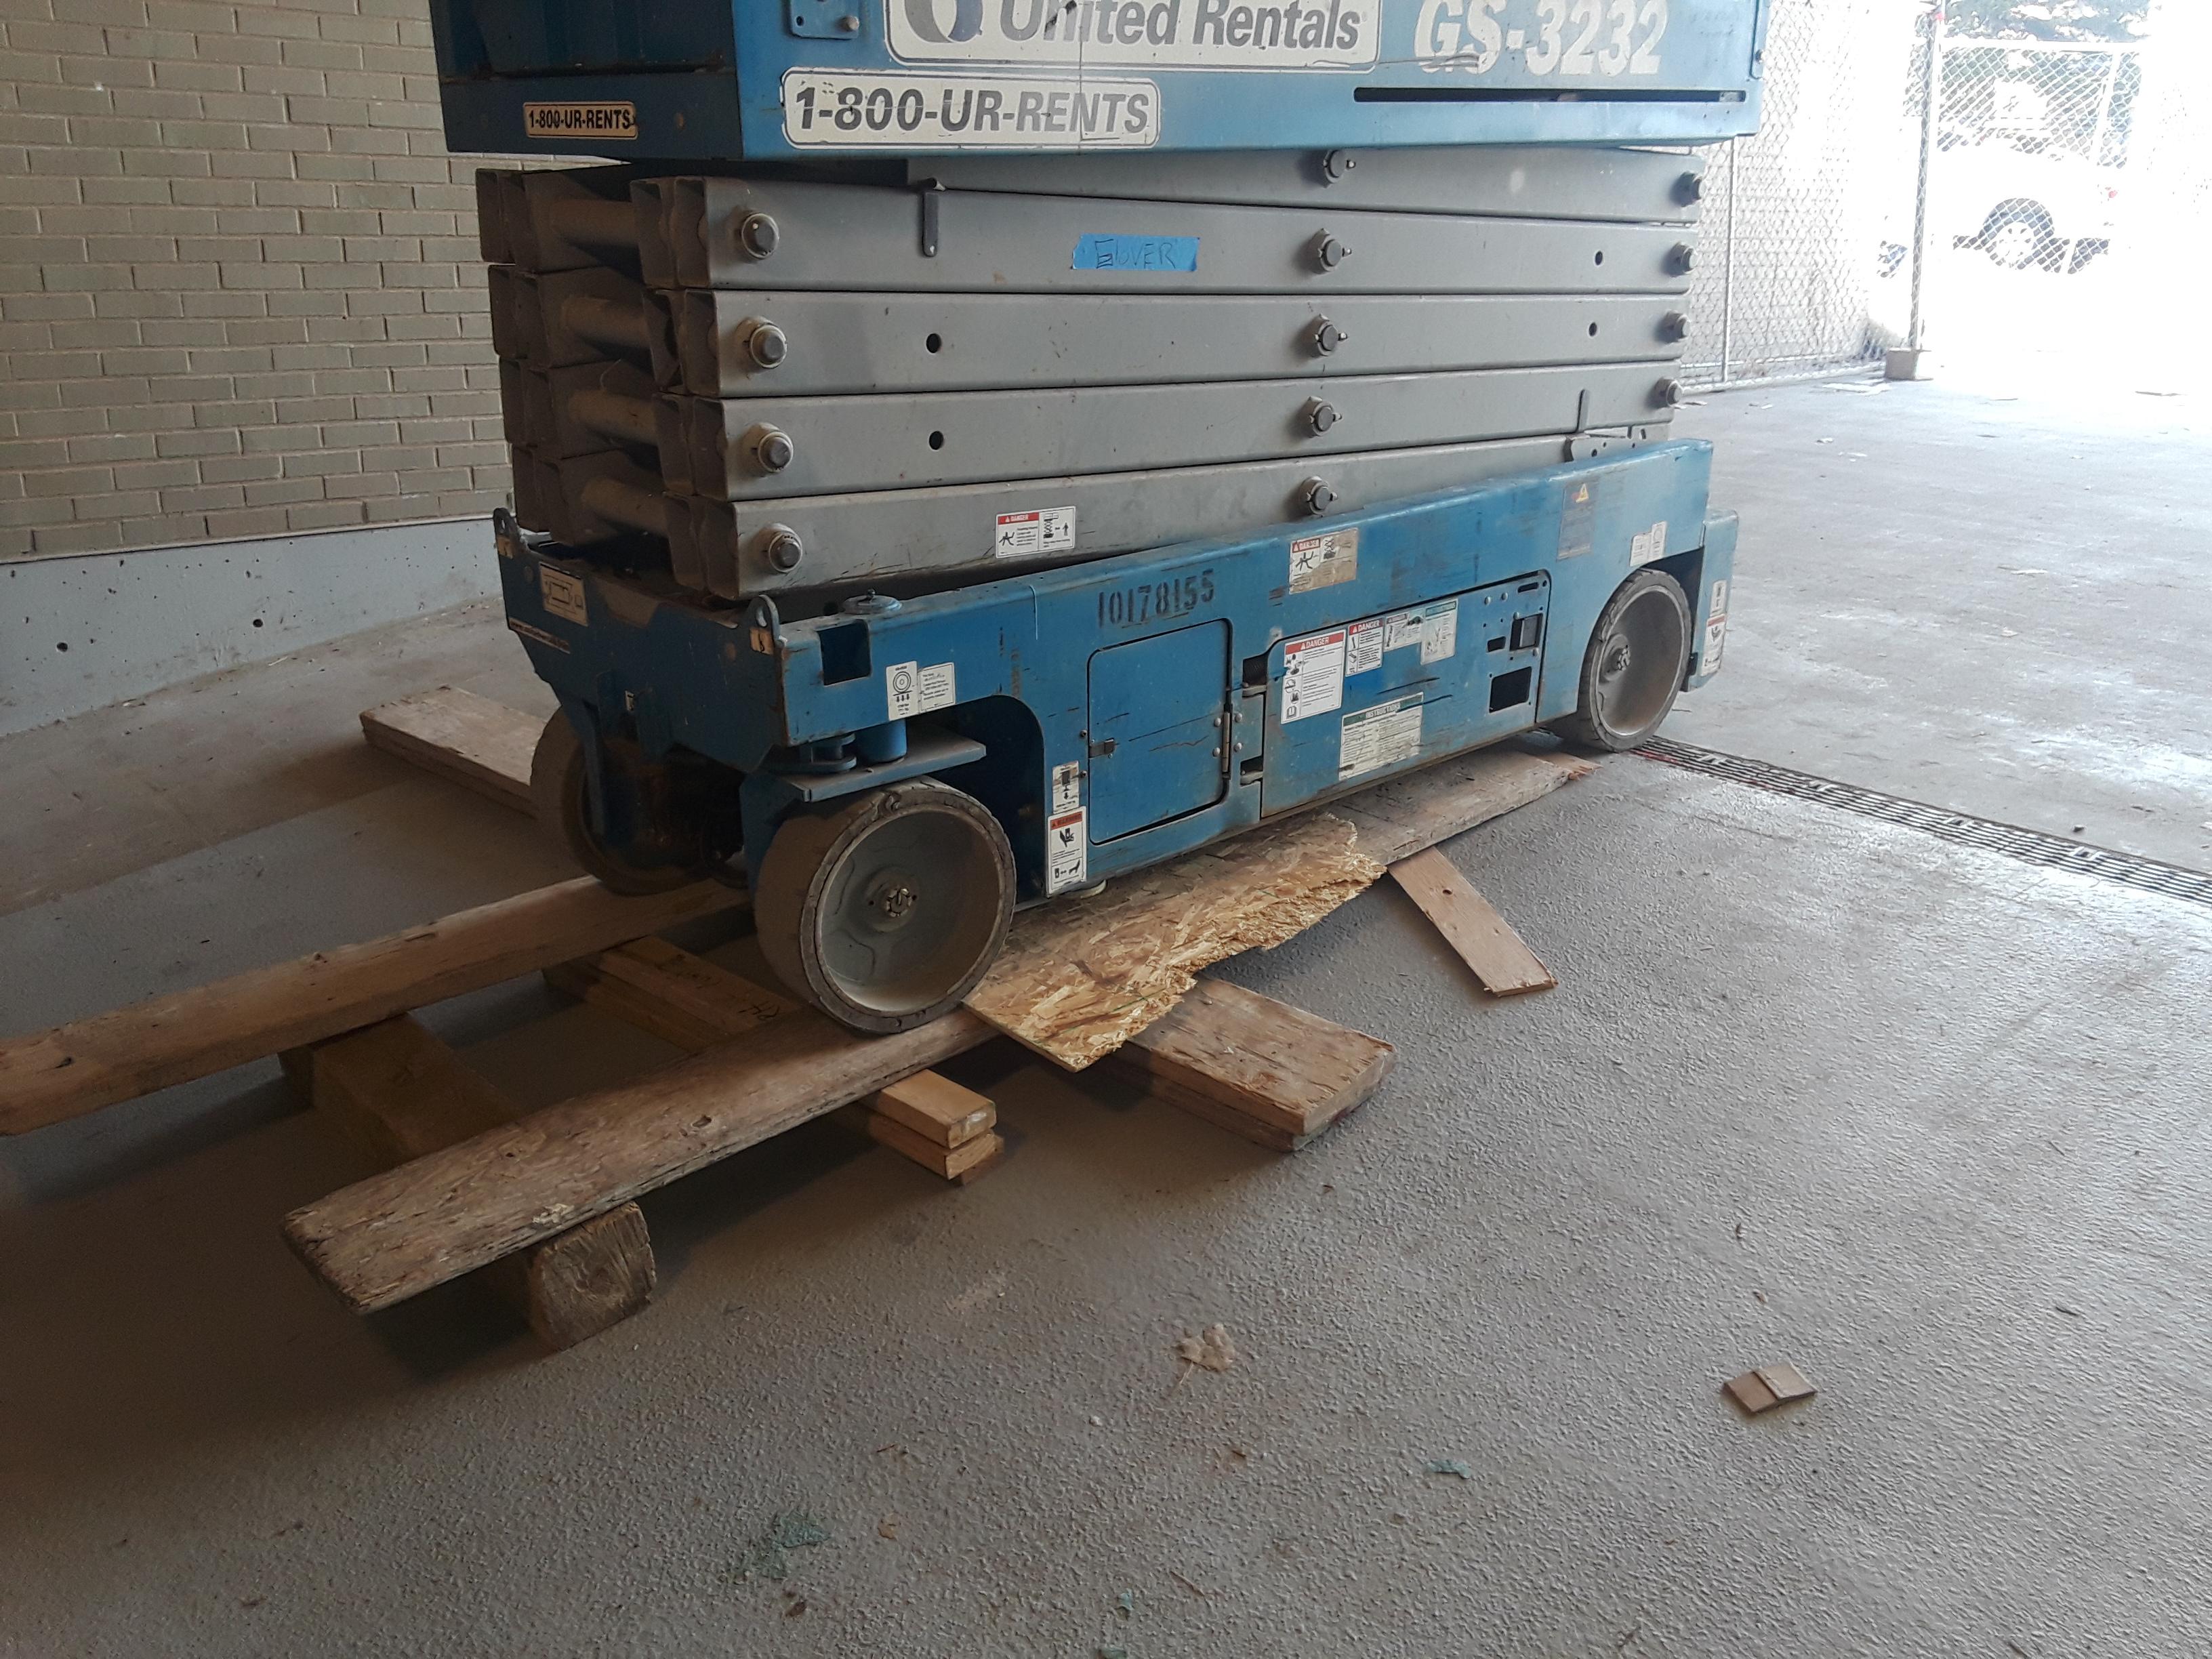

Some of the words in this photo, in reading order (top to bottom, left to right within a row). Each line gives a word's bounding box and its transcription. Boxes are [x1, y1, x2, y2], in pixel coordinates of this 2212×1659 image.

[1000, 0, 1180, 45] United
[1193, 0, 1360, 49] Rentals
[1414, 0, 1668, 77] GS-3232
[529, 109, 631, 129] 1-800-UR-RENTS
[796, 87, 1148, 133] 1-800-UR-RENTS
[1098, 568, 1214, 628] 10178155
[1306, 636, 1329, 650] DANGER
[1358, 619, 1380, 632] DANGER
